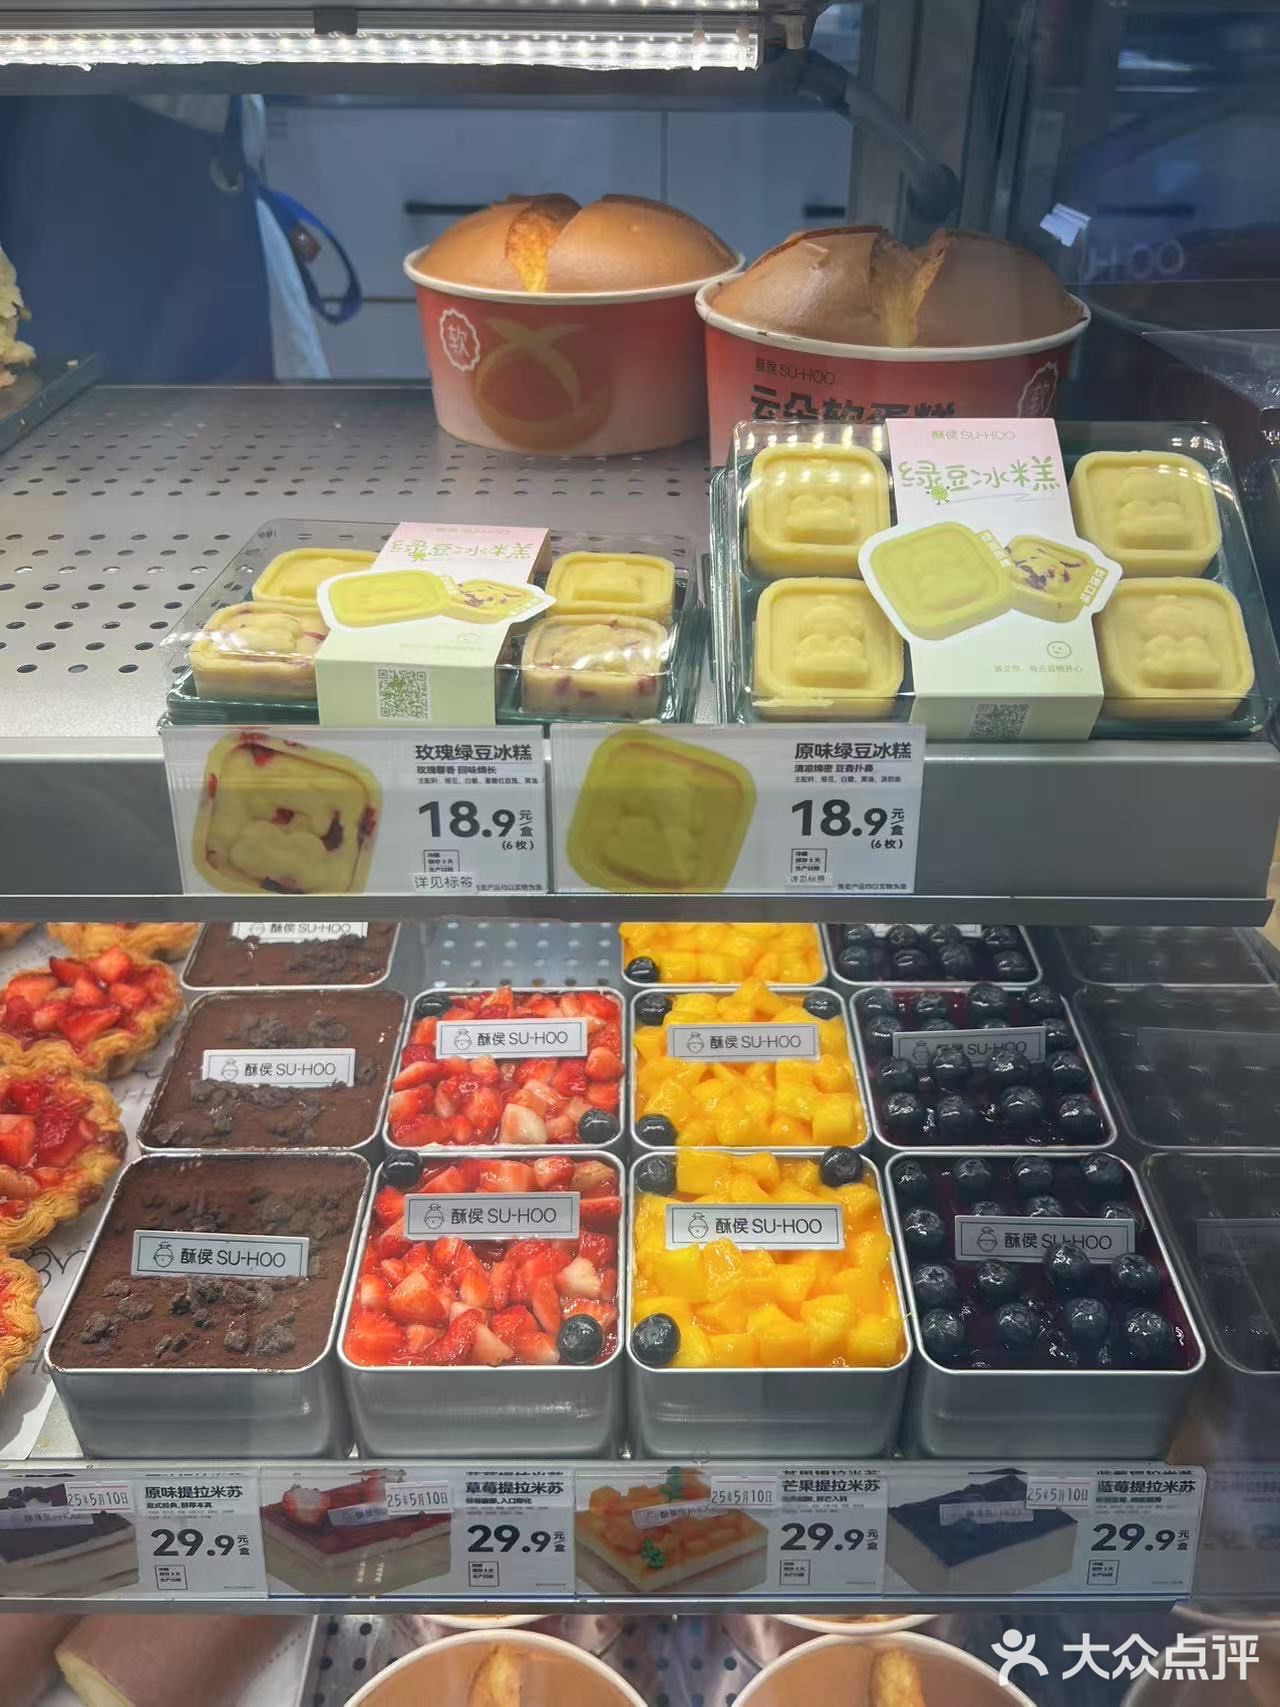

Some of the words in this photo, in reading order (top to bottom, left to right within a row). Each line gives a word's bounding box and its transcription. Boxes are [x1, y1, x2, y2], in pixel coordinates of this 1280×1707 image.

[960, 431, 1016, 441] SU-HOO
[898, 456, 1060, 491] 绿豆冰糕
[415, 744, 533, 761] 玫瑰绿豆冰糕
[795, 742, 912, 759] 原味绿豆冰糕
[419, 800, 516, 838] 18.9
[519, 809, 534, 837] 元/盒
[792, 799, 888, 837] 18.9
[891, 808, 905, 836] 元/盒
[477, 1032, 506, 1046] 酥侯
[509, 1031, 568, 1045] SU-HOO
[710, 1036, 738, 1049] 酥侯
[741, 1035, 801, 1048] SU-HOO
[244, 1063, 273, 1077] 酥侯
[276, 1062, 336, 1076] SU-HOO
[451, 1208, 483, 1224] 酥侯
[487, 1207, 557, 1223] SU-HOO
[715, 1218, 748, 1234] 酥侯
[752, 1218, 822, 1234] SU-HOO
[1004, 1232, 1037, 1248] 酥侯
[180, 1247, 213, 1265] 酥侯
[216, 1249, 286, 1268] SU-HOO
[145, 1486, 243, 1499] 原味提拉米苏
[465, 1481, 564, 1494] 草莓提拉米苏
[782, 1480, 880, 1492] 芒果提拉米苏
[1098, 1480, 1197, 1493] 蓝莓提拉米苏
[151, 1529, 235, 1556] 29.9
[467, 1524, 551, 1553] 29.9
[780, 1523, 865, 1552] 29.9
[1091, 1523, 1175, 1551] 29.9
